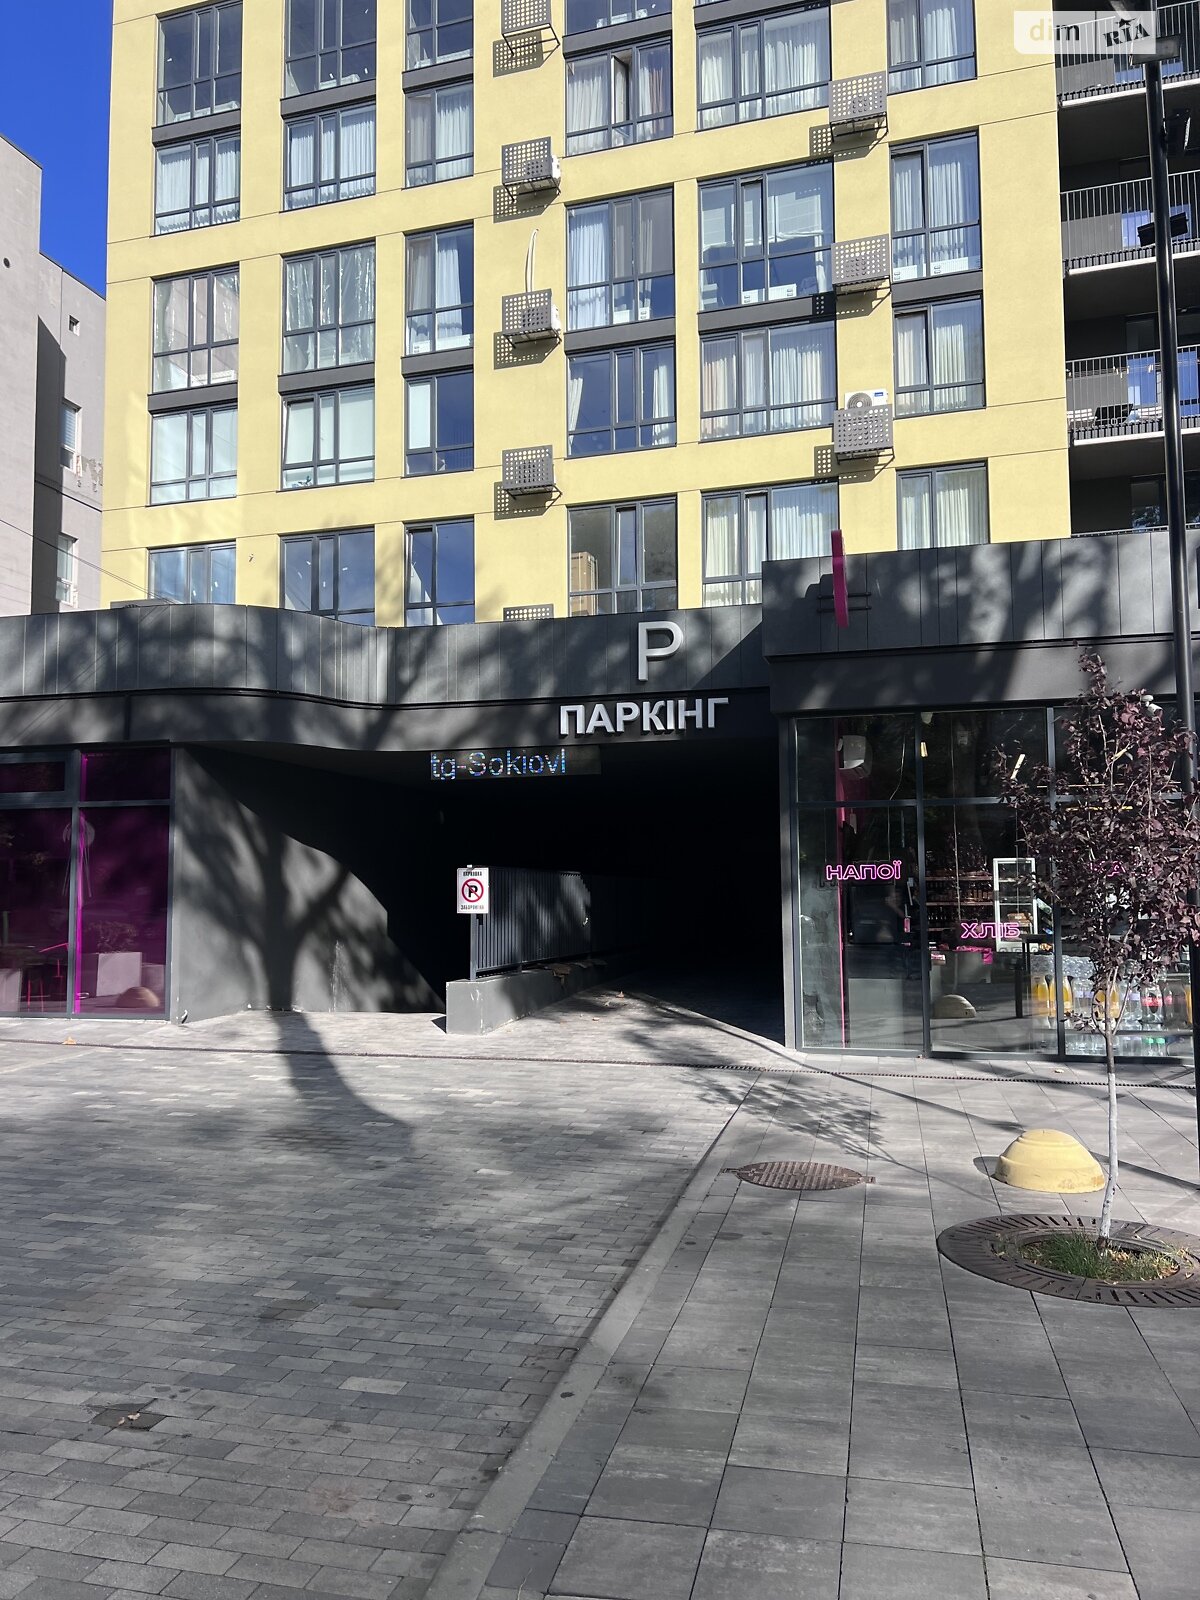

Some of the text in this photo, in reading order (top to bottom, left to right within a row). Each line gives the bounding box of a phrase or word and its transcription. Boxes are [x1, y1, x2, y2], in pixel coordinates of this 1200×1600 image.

[637, 621, 684, 682] P
[559, 697, 730, 736] ПАРКІНГ
[825, 859, 902, 881] НАПОЇ
[960, 921, 1021, 939] ХЛІБ
